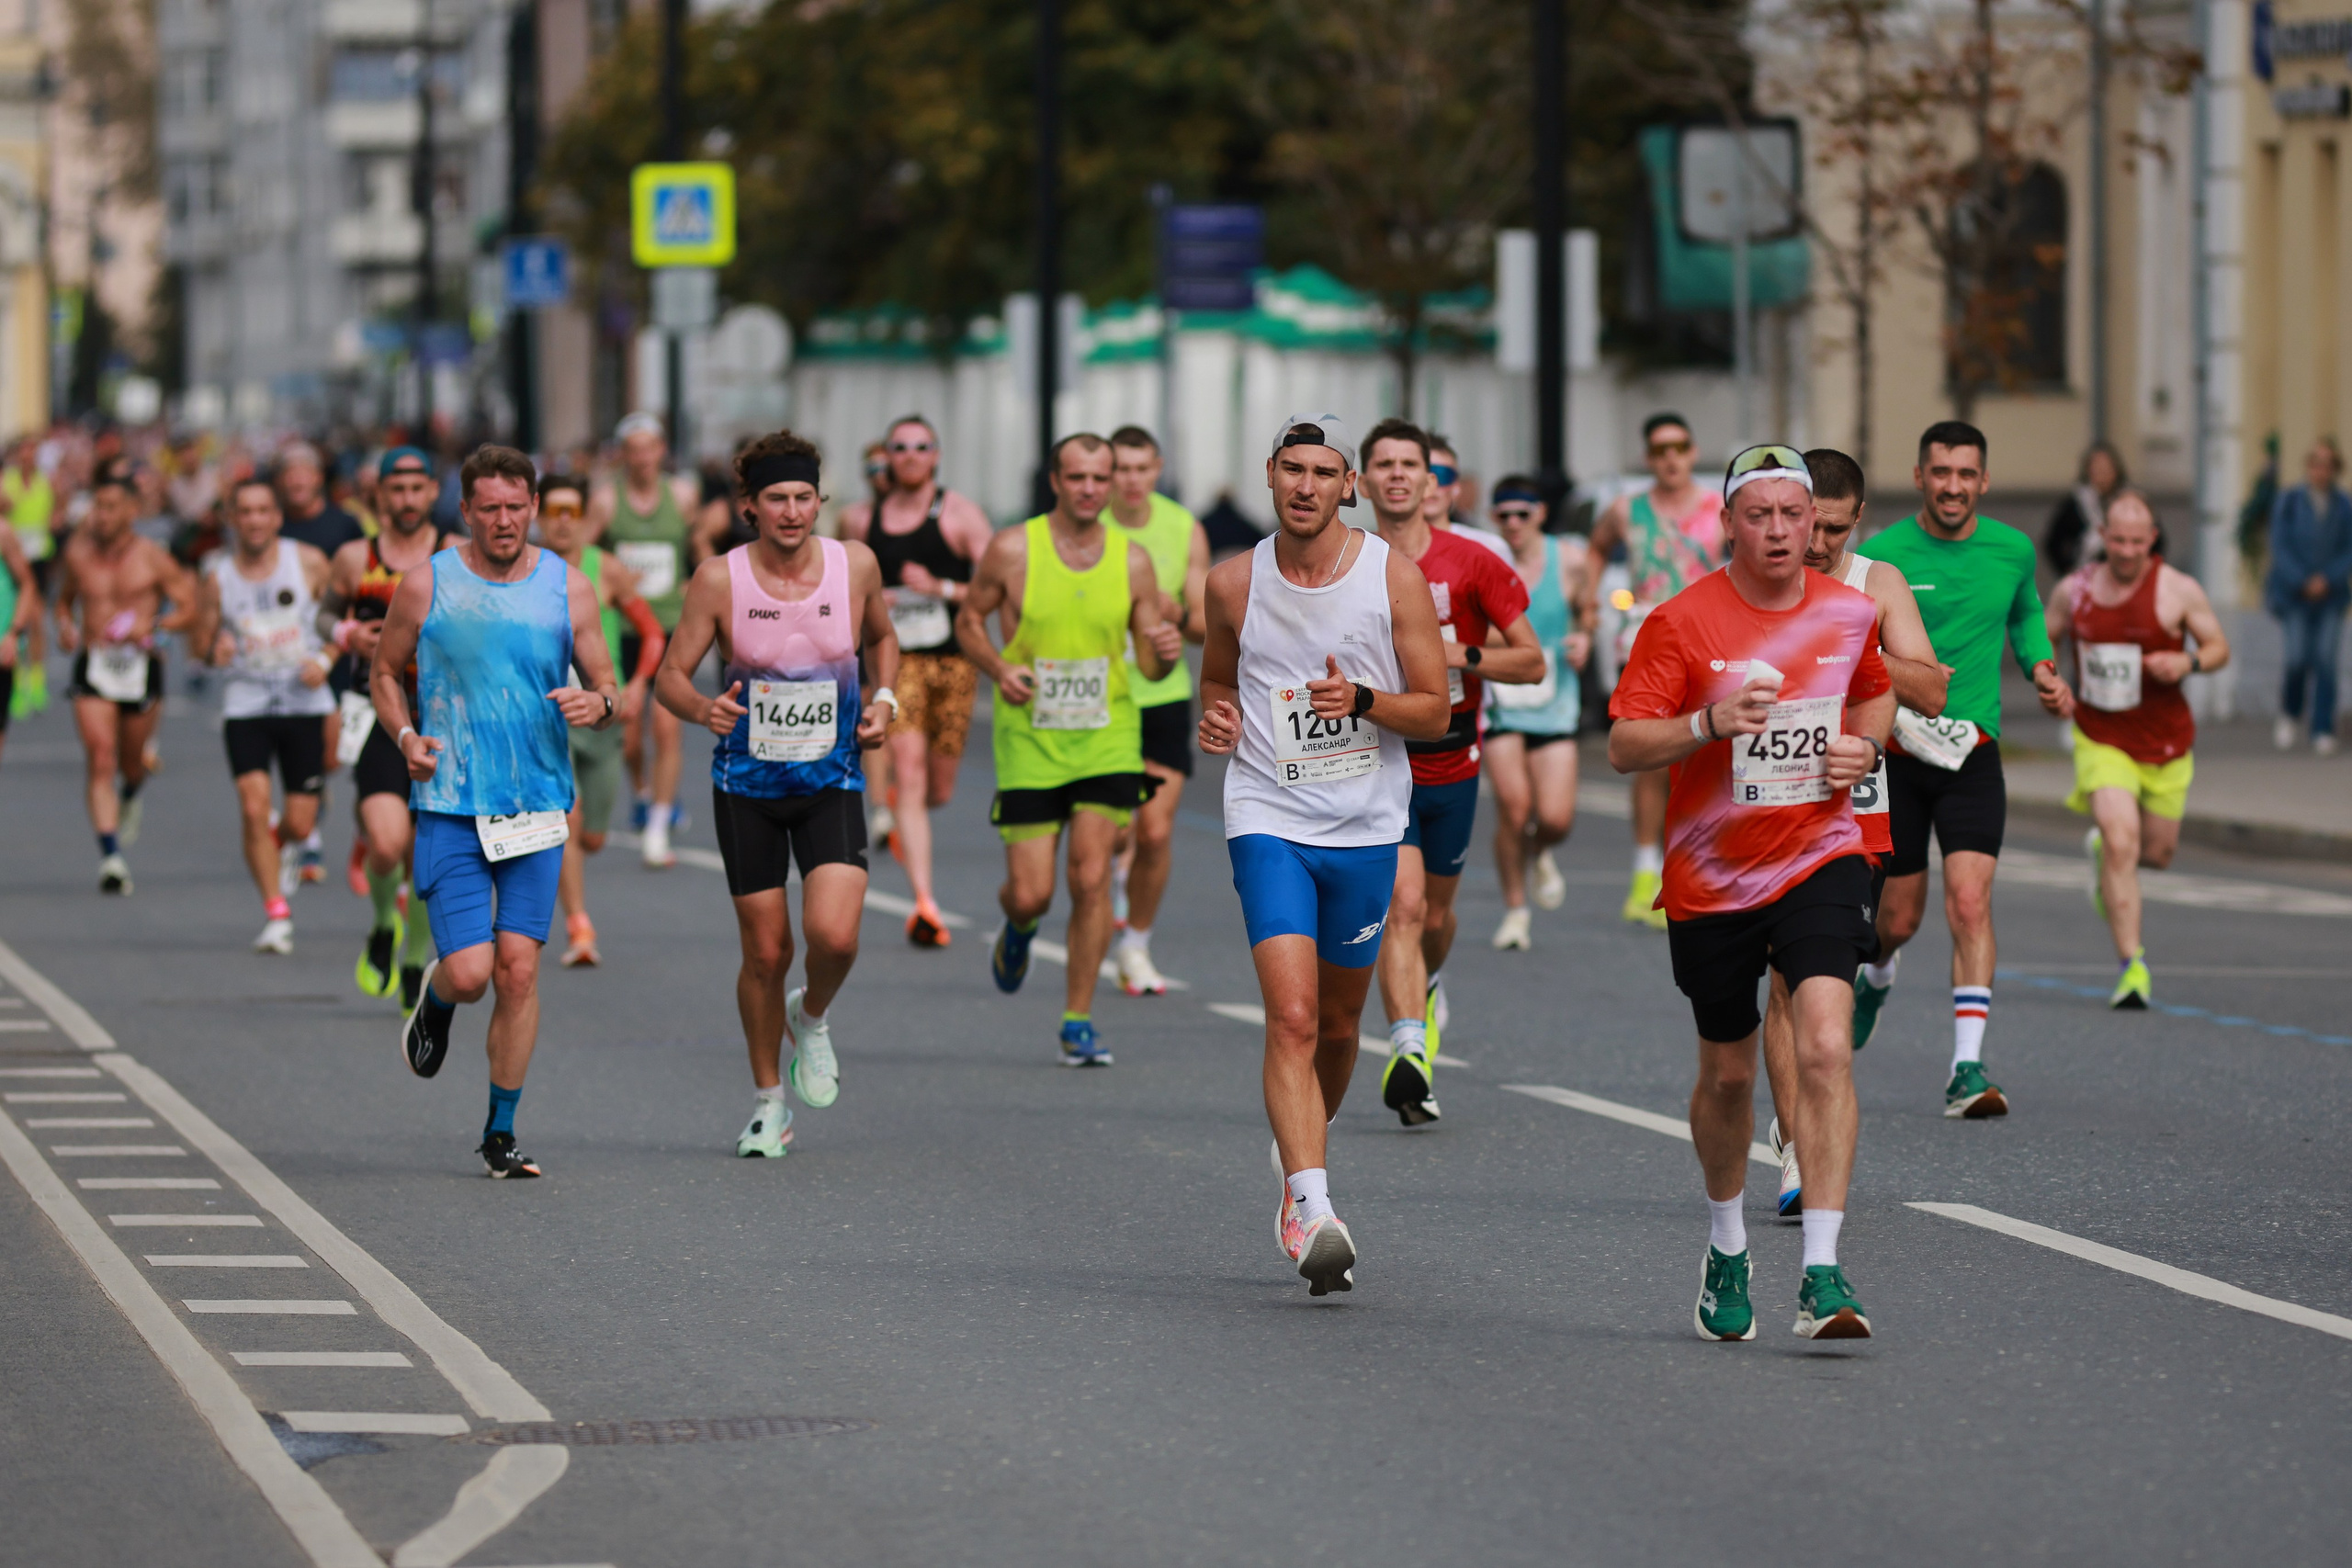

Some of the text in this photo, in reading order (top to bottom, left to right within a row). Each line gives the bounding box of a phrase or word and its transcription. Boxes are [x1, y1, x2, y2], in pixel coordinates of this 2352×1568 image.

[749, 608, 781, 620] DWC
[1045, 676, 1101, 699] 3700
[754, 702, 832, 727] 14648
[1912, 709, 1968, 747] 32
[1302, 738, 1351, 752] АЛЕКСАНДР
[1747, 727, 1827, 761] 4528
[1771, 763, 1810, 773] ЛЕОНИД
